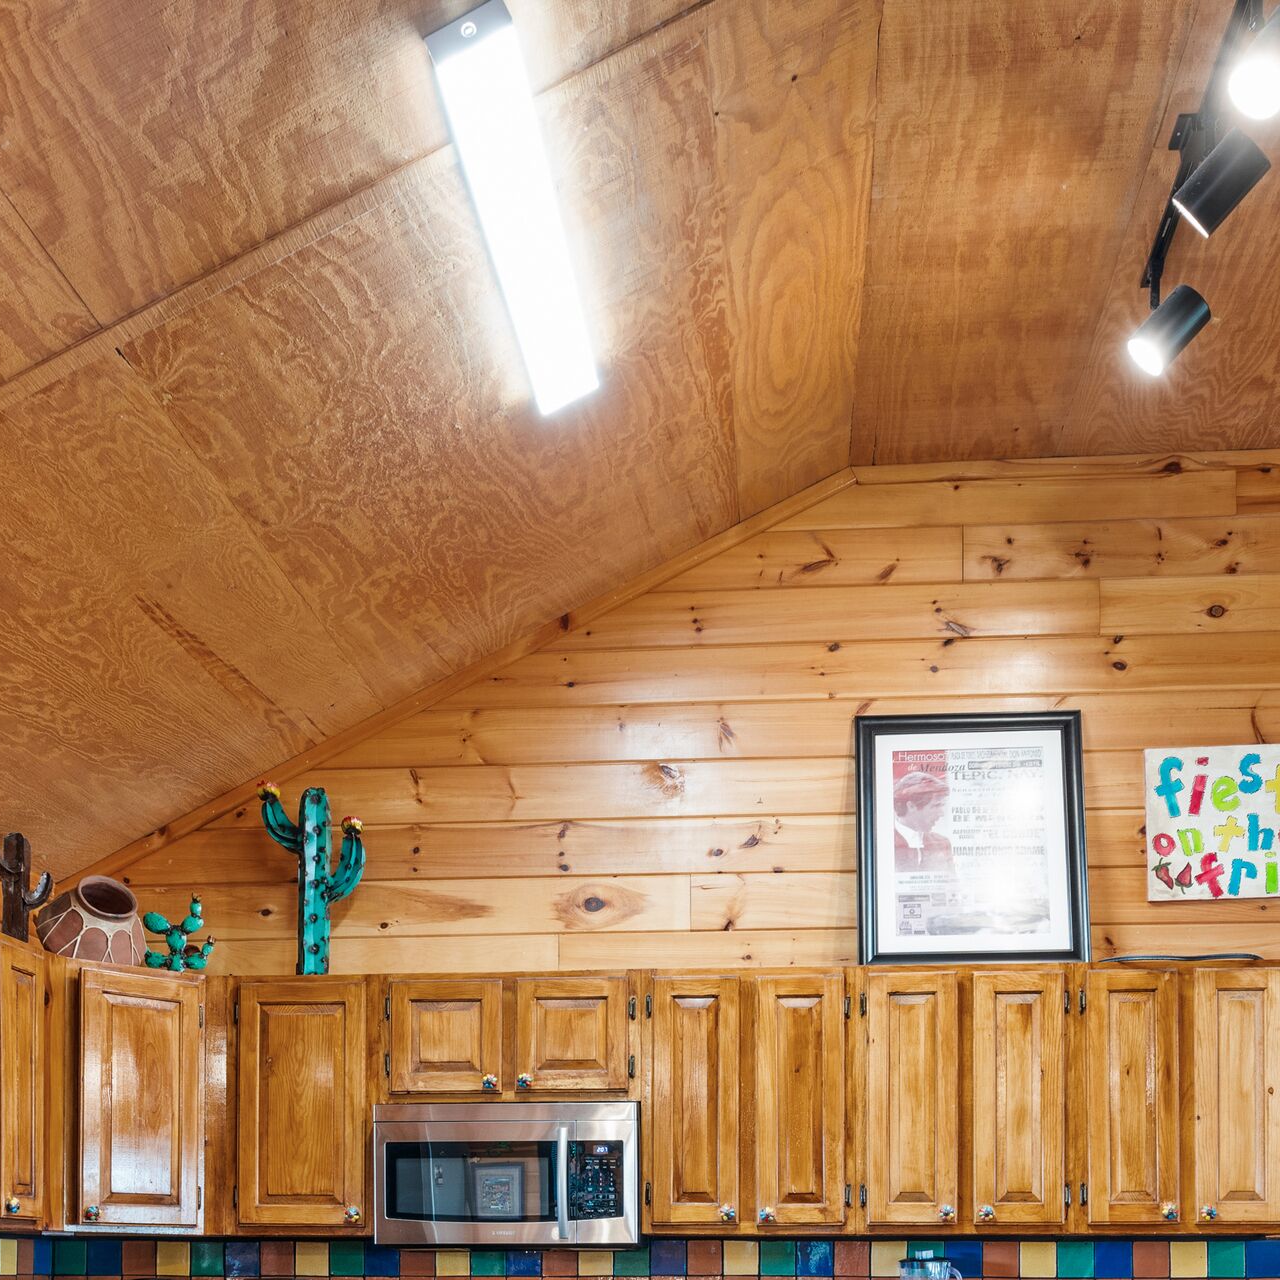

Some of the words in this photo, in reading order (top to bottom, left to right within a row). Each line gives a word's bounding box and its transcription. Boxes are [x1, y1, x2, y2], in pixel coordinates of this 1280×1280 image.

[898, 751, 945, 762] Hermoso
[907, 763, 918, 771] de
[918, 762, 968, 773] Mendoza
[1152, 827, 1204, 857] on
